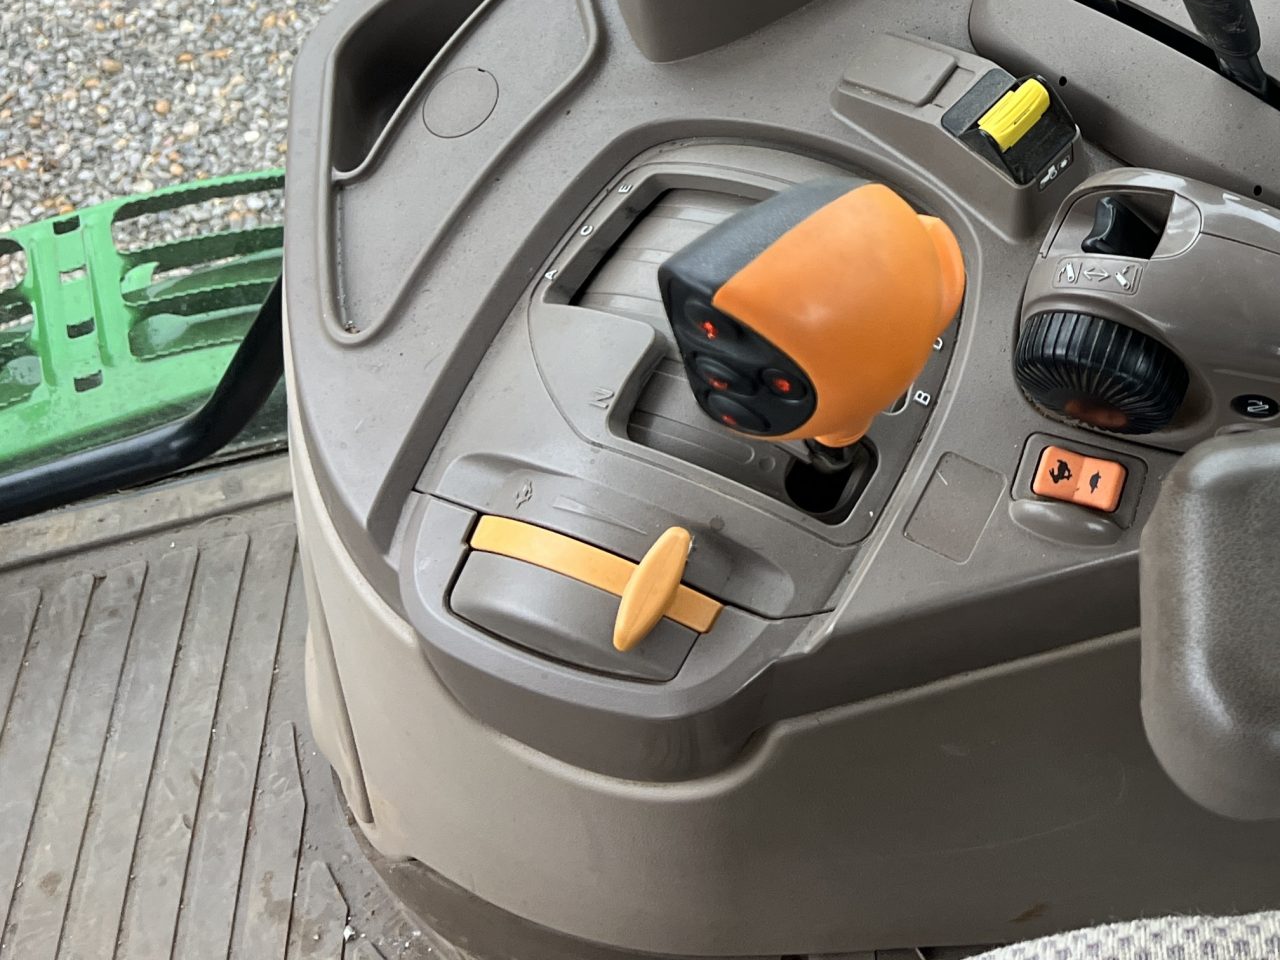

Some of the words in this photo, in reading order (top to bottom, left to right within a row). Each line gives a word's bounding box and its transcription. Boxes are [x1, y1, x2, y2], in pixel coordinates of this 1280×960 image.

[617, 183, 634, 193] E
[580, 225, 593, 236] C
[544, 269, 559, 280] A
[913, 390, 931, 406] B
